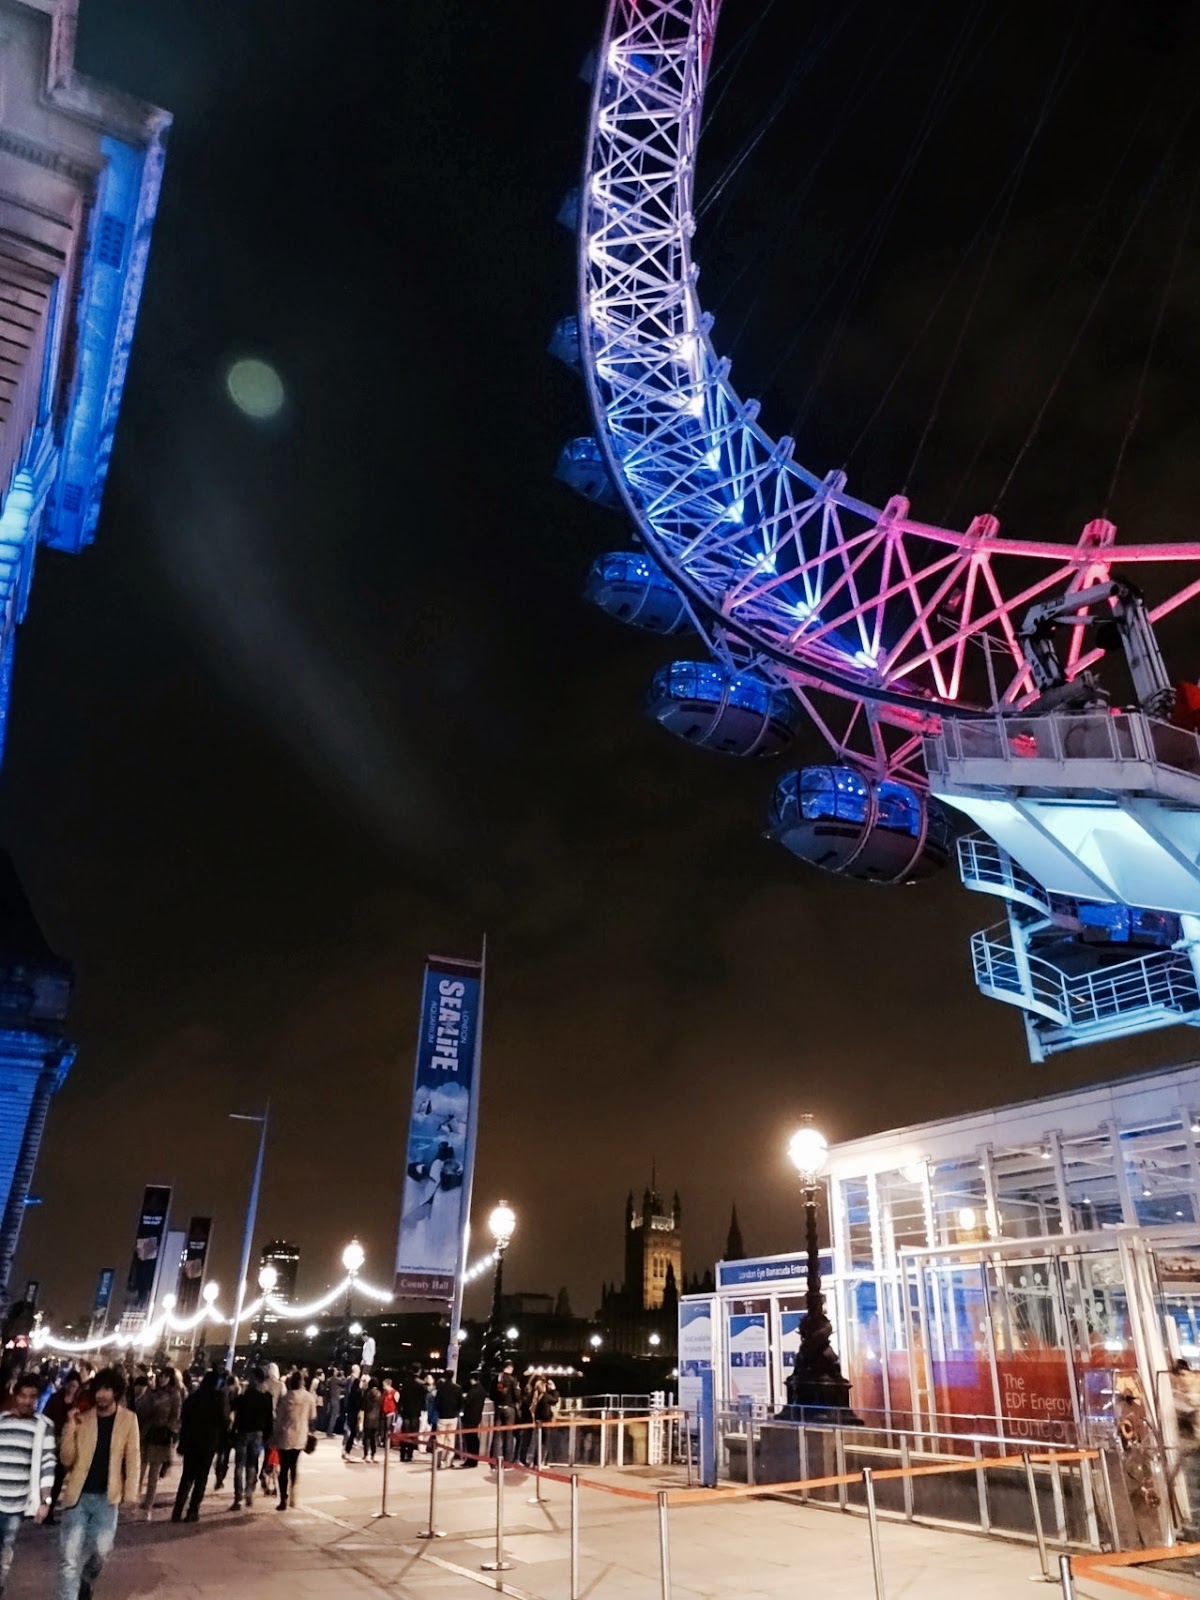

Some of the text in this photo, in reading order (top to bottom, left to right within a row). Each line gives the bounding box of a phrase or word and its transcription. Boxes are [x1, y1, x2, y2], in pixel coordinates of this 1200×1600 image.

[439, 980, 465, 1021] SEA
[428, 1001, 437, 1043] AQUARIUM
[461, 1011, 469, 1044] LONDON
[757, 1268, 766, 1279] Eye
[791, 1264, 808, 1273] Entran
[401, 1279, 449, 1290] County Hall
[1003, 1373, 1025, 1390] The
[1005, 1392, 1072, 1416] EDF Energy
